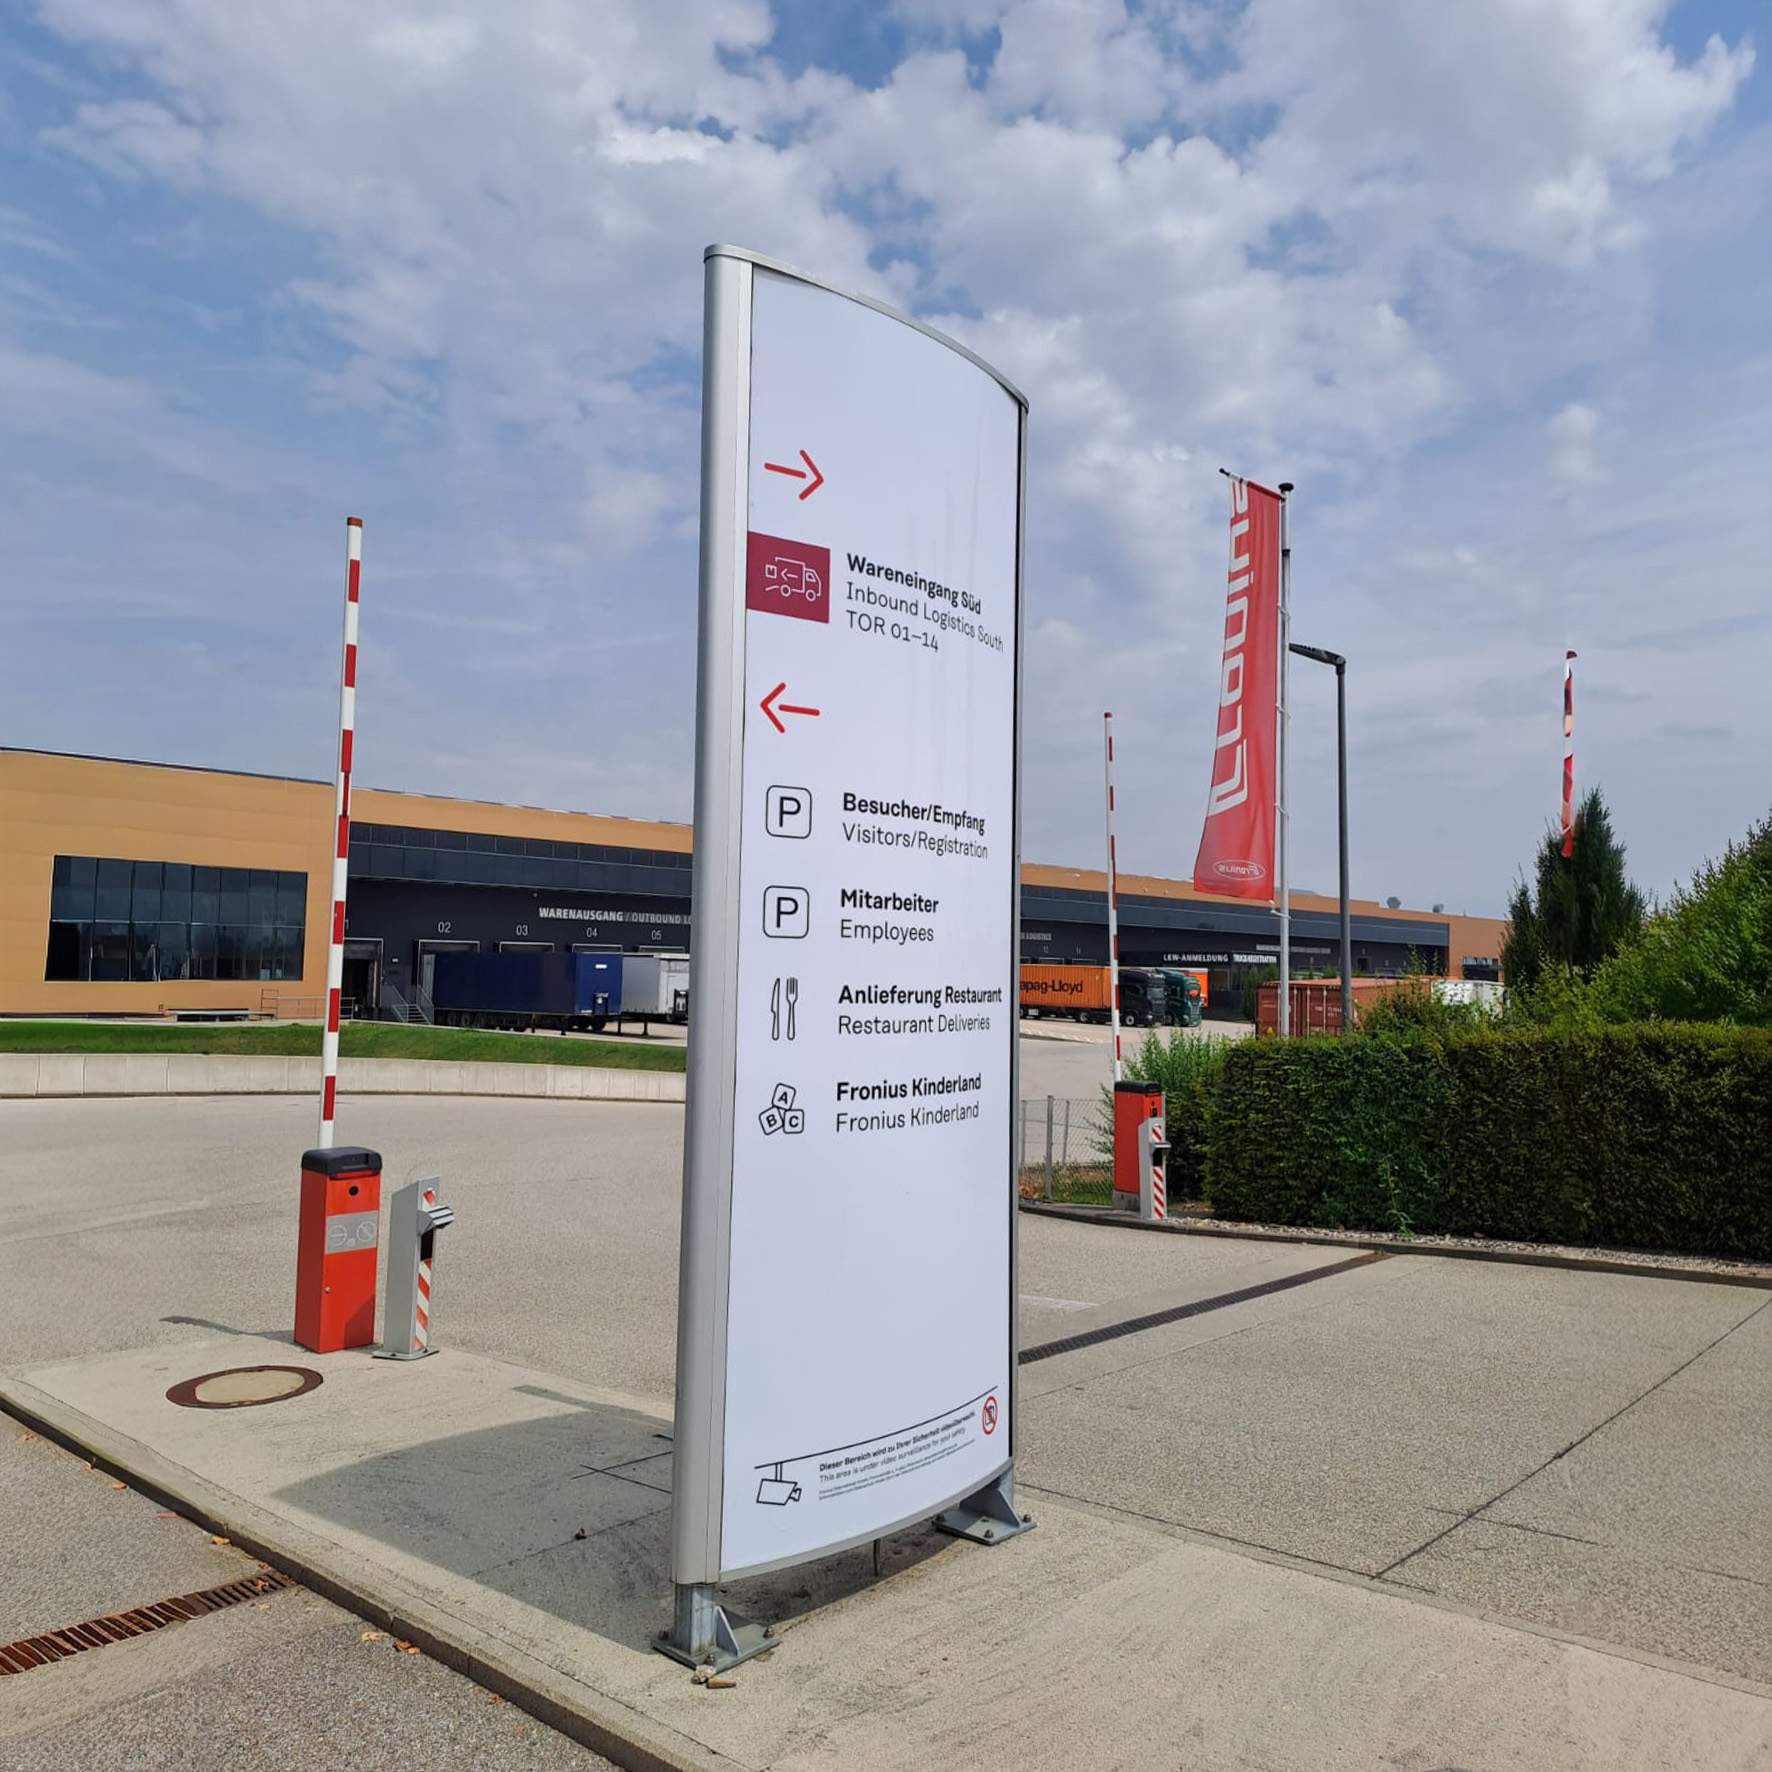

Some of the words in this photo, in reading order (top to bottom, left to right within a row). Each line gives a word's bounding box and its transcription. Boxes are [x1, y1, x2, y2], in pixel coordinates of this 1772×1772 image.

[847, 552, 959, 608] Wareneingang
[961, 591, 981, 615] Süd
[846, 581, 919, 616] Inbound
[923, 602, 976, 639] Logistics
[977, 625, 1004, 653] South
[846, 609, 886, 636] TOR
[778, 796, 802, 828] P
[843, 792, 986, 836] Besucher/Empfang
[843, 822, 988, 859] Visitors/Registration
[775, 897, 799, 928] P
[840, 888, 940, 913] Mitarbeiter
[438, 921, 451, 934] 02
[539, 907, 623, 922] WARENAUSGANG
[632, 912, 681, 925] OUTBOUND
[516, 925, 529, 937] 03
[586, 927, 598, 938] 04
[651, 930, 662, 940] 05
[840, 919, 934, 945] Employees
[1163, 953, 1228, 963] LKW-ANMELDUNG
[838, 985, 942, 1008] Anlieferung
[945, 986, 1002, 1003] Restaurant
[1019, 979, 1083, 995] apag-Lloyd
[838, 1014, 934, 1035] Restaurant
[938, 1014, 990, 1032] Deliveries
[777, 1091, 788, 1104] A
[836, 1081, 907, 1101] Fronius
[911, 1073, 982, 1096] Kinderland
[788, 1115, 799, 1128] C
[836, 1111, 905, 1132] Fronius
[910, 1101, 979, 1126] Kinderland
[819, 1461, 843, 1472] Dieser
[844, 1452, 871, 1466] Bereich
[872, 1445, 887, 1458] wird
[887, 1445, 896, 1454] zu
[819, 1473, 834, 1484] This
[835, 1469, 851, 1479] area
